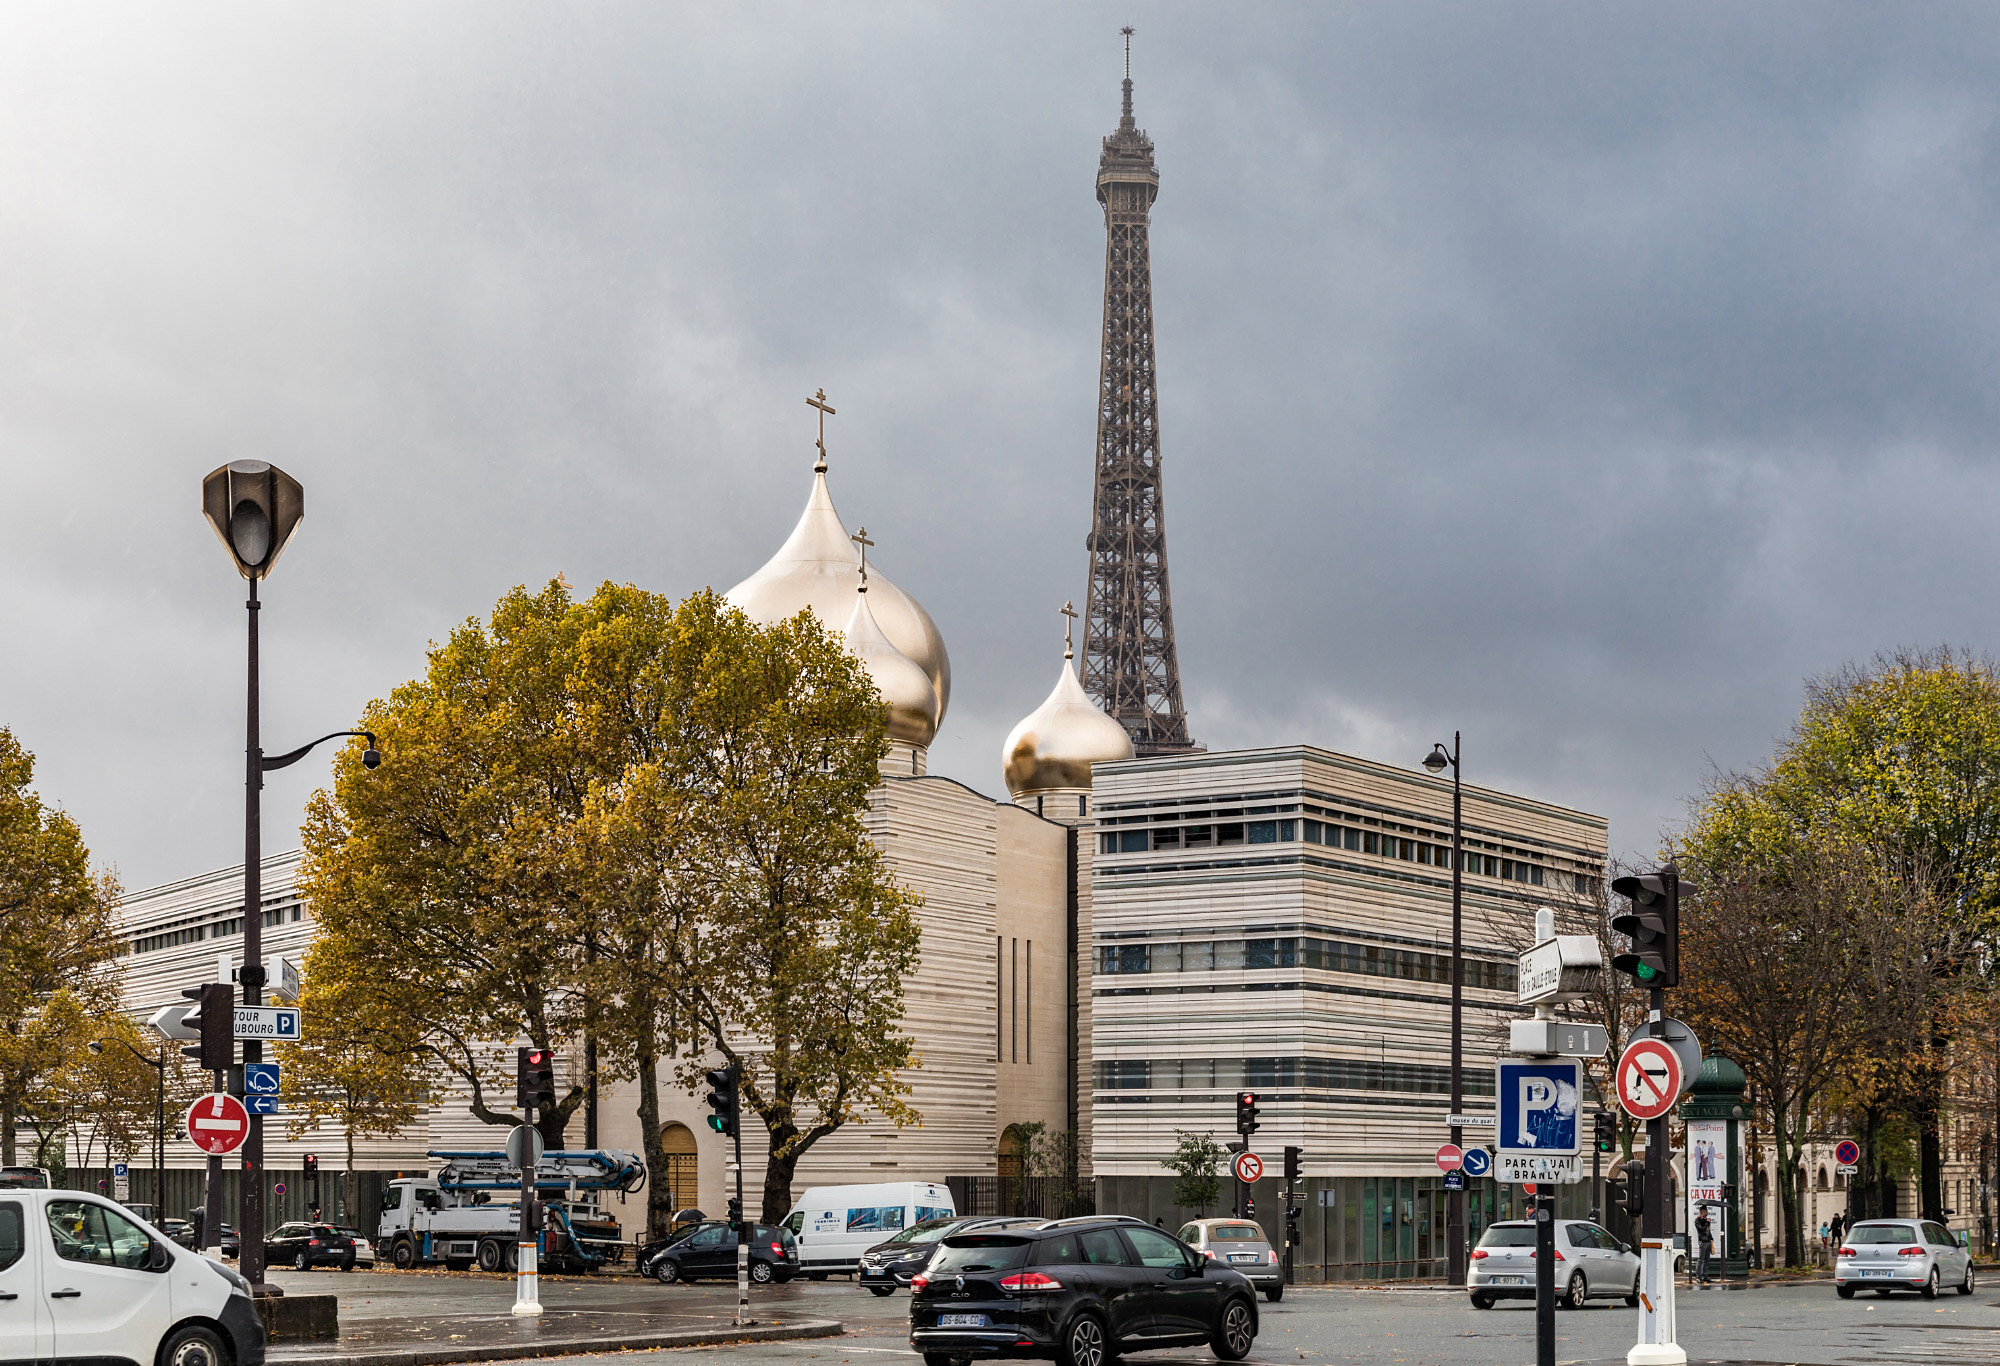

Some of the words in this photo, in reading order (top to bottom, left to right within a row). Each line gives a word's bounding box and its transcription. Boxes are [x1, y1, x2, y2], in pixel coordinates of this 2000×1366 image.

[1520, 957, 1532, 975] PLACE
[234, 1011, 259, 1022] TOUR
[281, 1016, 290, 1031] P
[1480, 1118, 1493, 1126] quai
[1505, 1158, 1535, 1168] PARC
[117, 1165, 125, 1174] P
[1514, 1170, 1560, 1180] BRANLY
[1690, 1189, 1700, 1200] ÇA
[1701, 1189, 1716, 1199] VA
